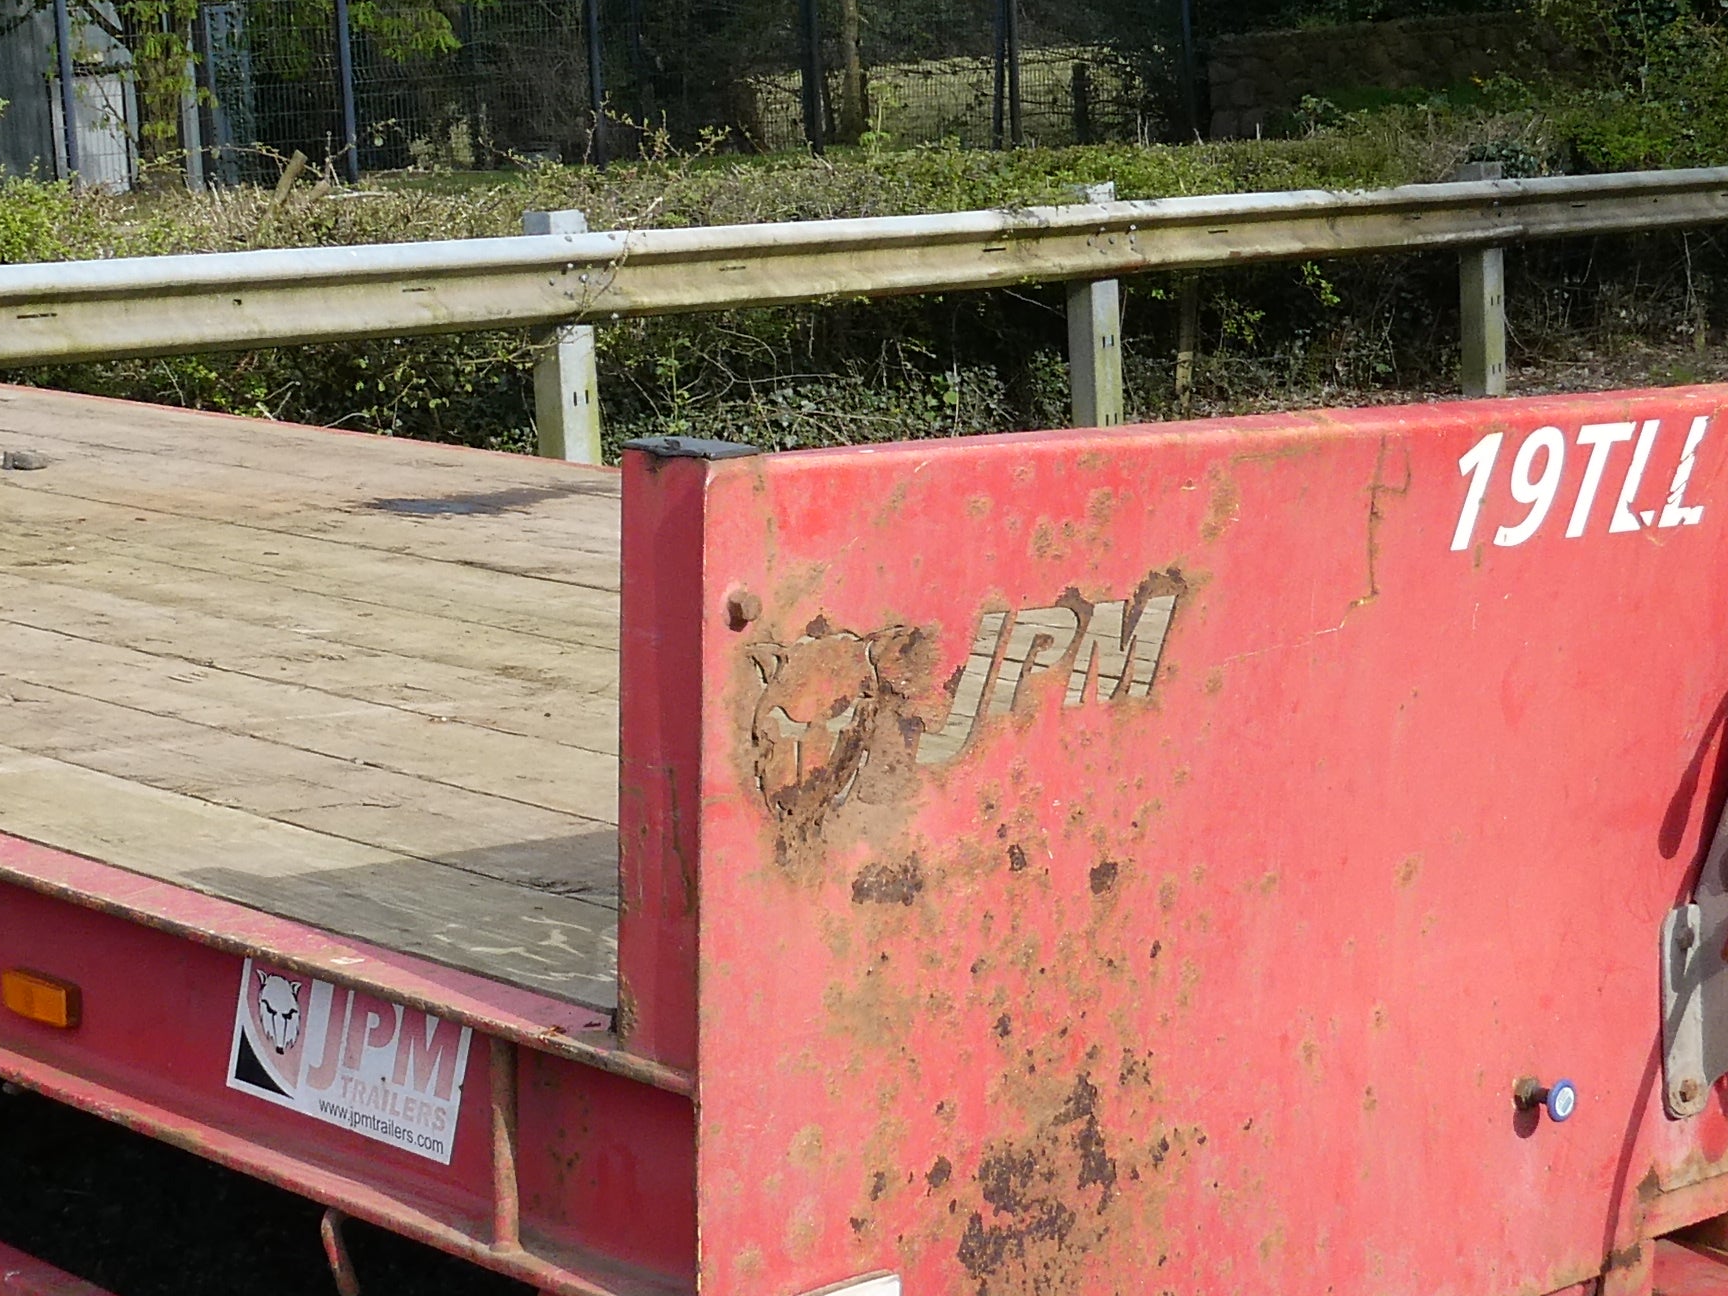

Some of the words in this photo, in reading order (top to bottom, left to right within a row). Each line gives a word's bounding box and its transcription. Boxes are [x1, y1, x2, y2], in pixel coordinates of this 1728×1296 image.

[1450, 415, 1704, 551] 19TLL
[915, 595, 1177, 764] JPM
[306, 984, 463, 1102] JPM
[318, 1099, 444, 1155] www.jpmtrailers.com
[340, 1075, 449, 1132] TRAILERS
